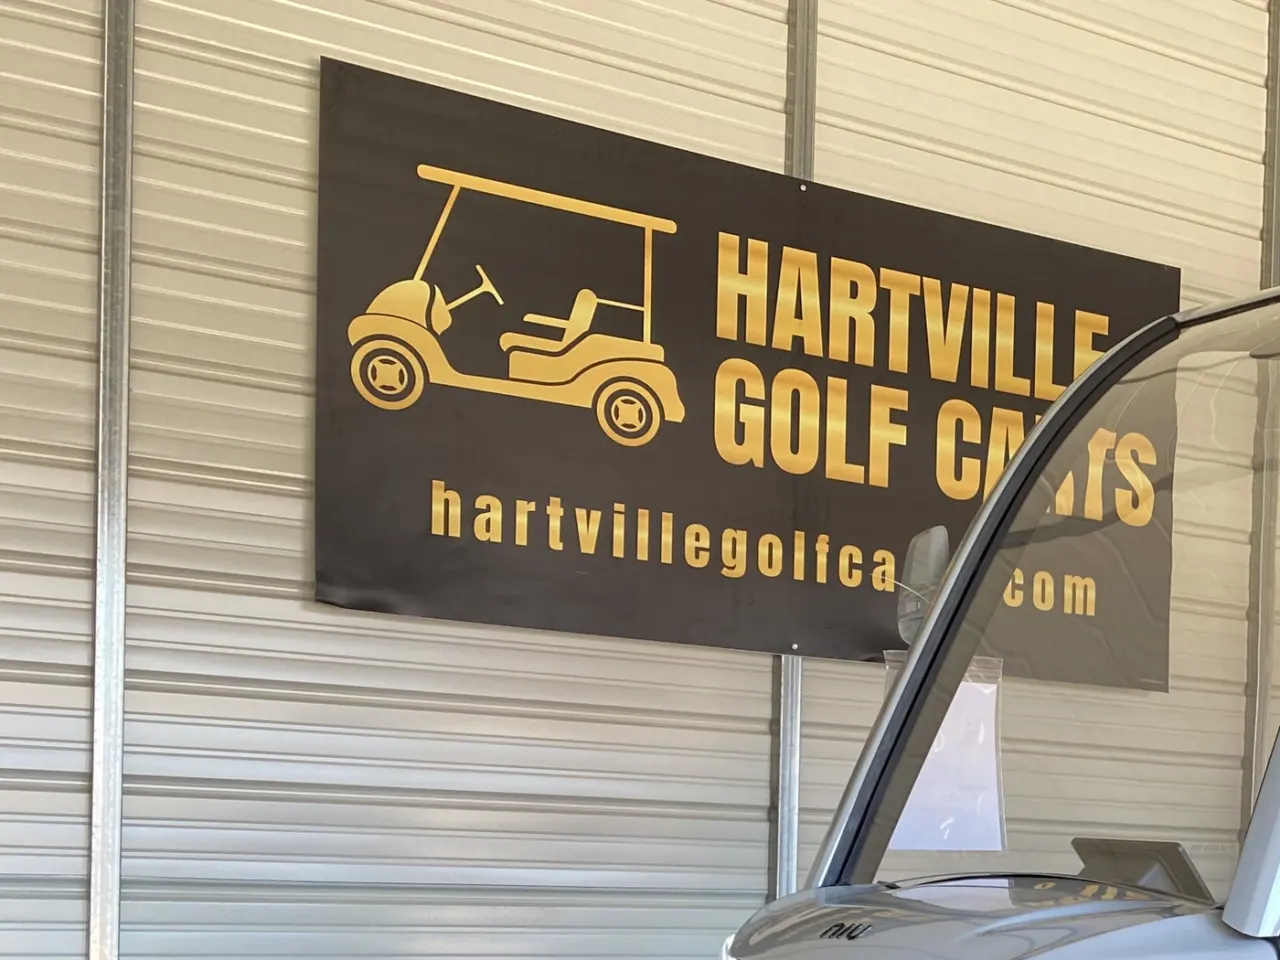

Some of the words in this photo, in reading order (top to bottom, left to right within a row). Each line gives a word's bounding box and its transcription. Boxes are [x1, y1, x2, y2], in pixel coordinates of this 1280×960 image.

[716, 231, 1109, 402] HARTVILLE
[713, 357, 909, 488] GOLF
[935, 399, 1157, 527] CATS
[431, 479, 1097, 616] hartvillegolfcacom
